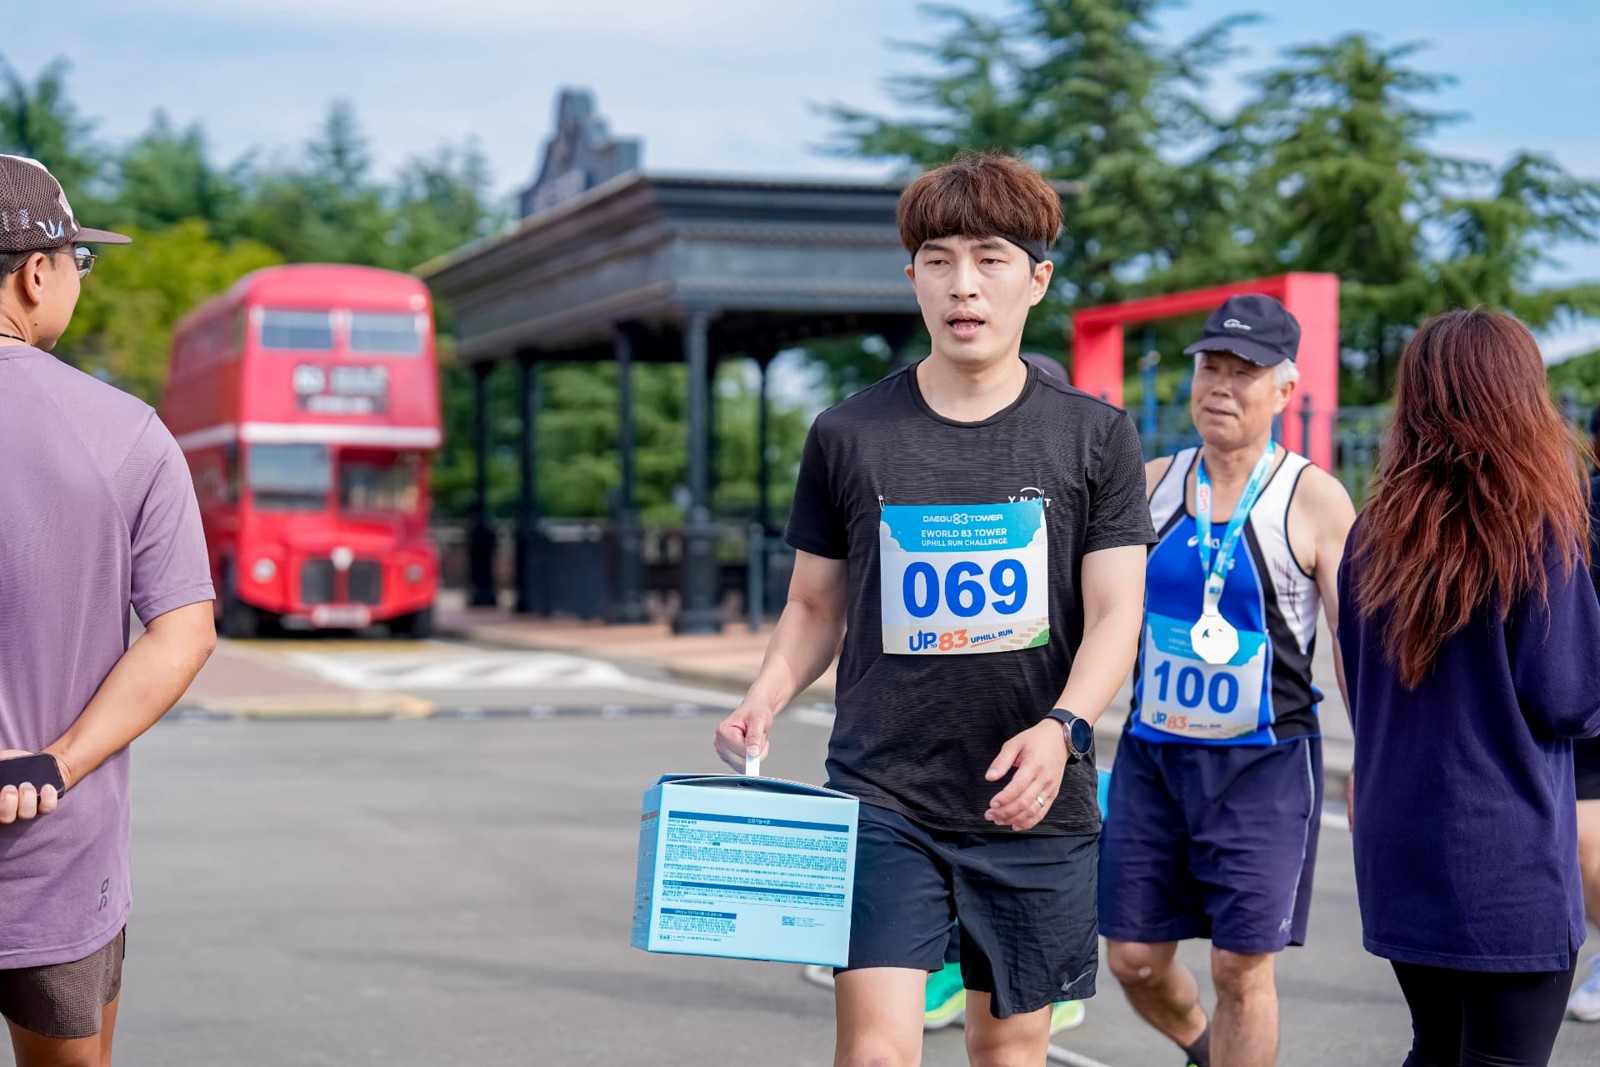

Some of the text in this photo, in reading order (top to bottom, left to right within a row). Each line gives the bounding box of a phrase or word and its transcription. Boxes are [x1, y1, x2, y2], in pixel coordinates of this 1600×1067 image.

[1008, 495, 1052, 508] YNT
[922, 512, 1004, 525] DAEGU 83 TOWER
[921, 527, 1007, 538] EWORLD 83 TOWER
[921, 537, 1008, 547] UPHILL RUN CHALLENGE
[902, 558, 1029, 618] 069
[908, 629, 937, 652] UP
[938, 628, 969, 652] 83
[970, 632, 997, 644] UPHILL
[998, 628, 1013, 638] RUN
[1153, 659, 1239, 714] 100
[1167, 715, 1188, 730] 83
